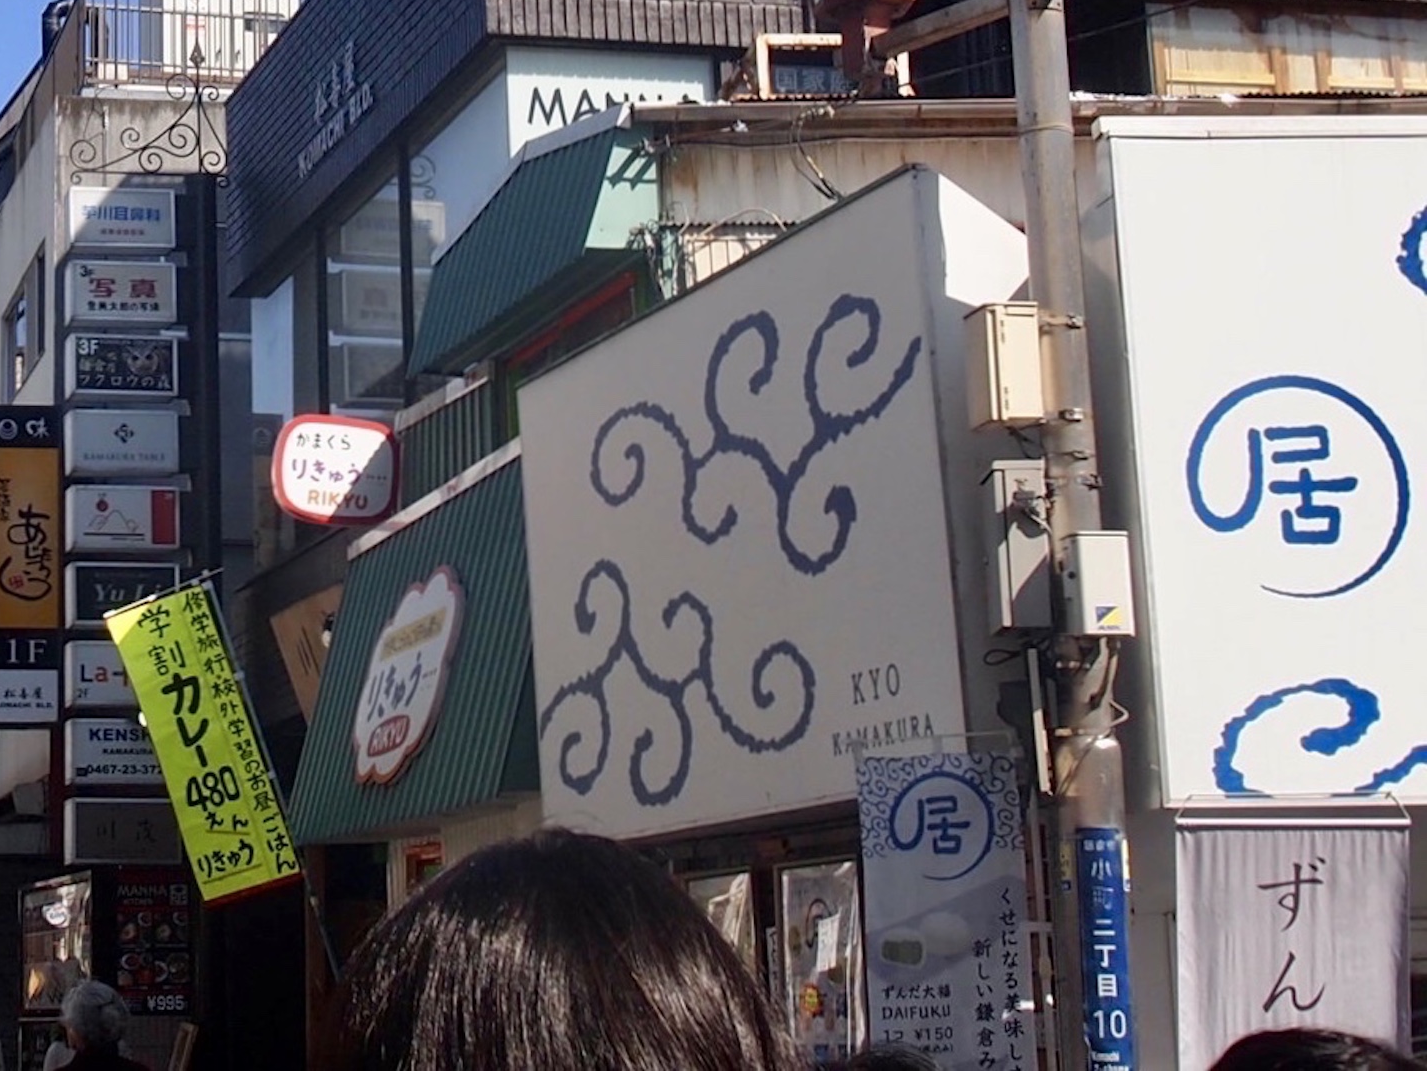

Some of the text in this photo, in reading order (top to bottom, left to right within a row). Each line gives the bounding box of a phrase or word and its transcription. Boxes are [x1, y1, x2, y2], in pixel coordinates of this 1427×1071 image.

[89, 278, 158, 298] 写真
[78, 339, 99, 355] 3F
[296, 433, 351, 450] かまくら
[292, 459, 362, 485] りきゅう
[307, 490, 368, 509] RIKYU
[7, 638, 47, 663] 1F
[851, 664, 901, 705] KYO
[833, 713, 935, 757] KAMAKURA
[198, 838, 254, 878] りきゅう
[1090, 858, 1117, 998] 小町二丁目
[1258, 857, 1326, 1013] ずん
[882, 984, 951, 999] ずんだ大福
[882, 1005, 951, 1020] DAIFUKU
[1092, 1010, 1127, 1039] 10
[915, 1027, 953, 1041] ¥150
